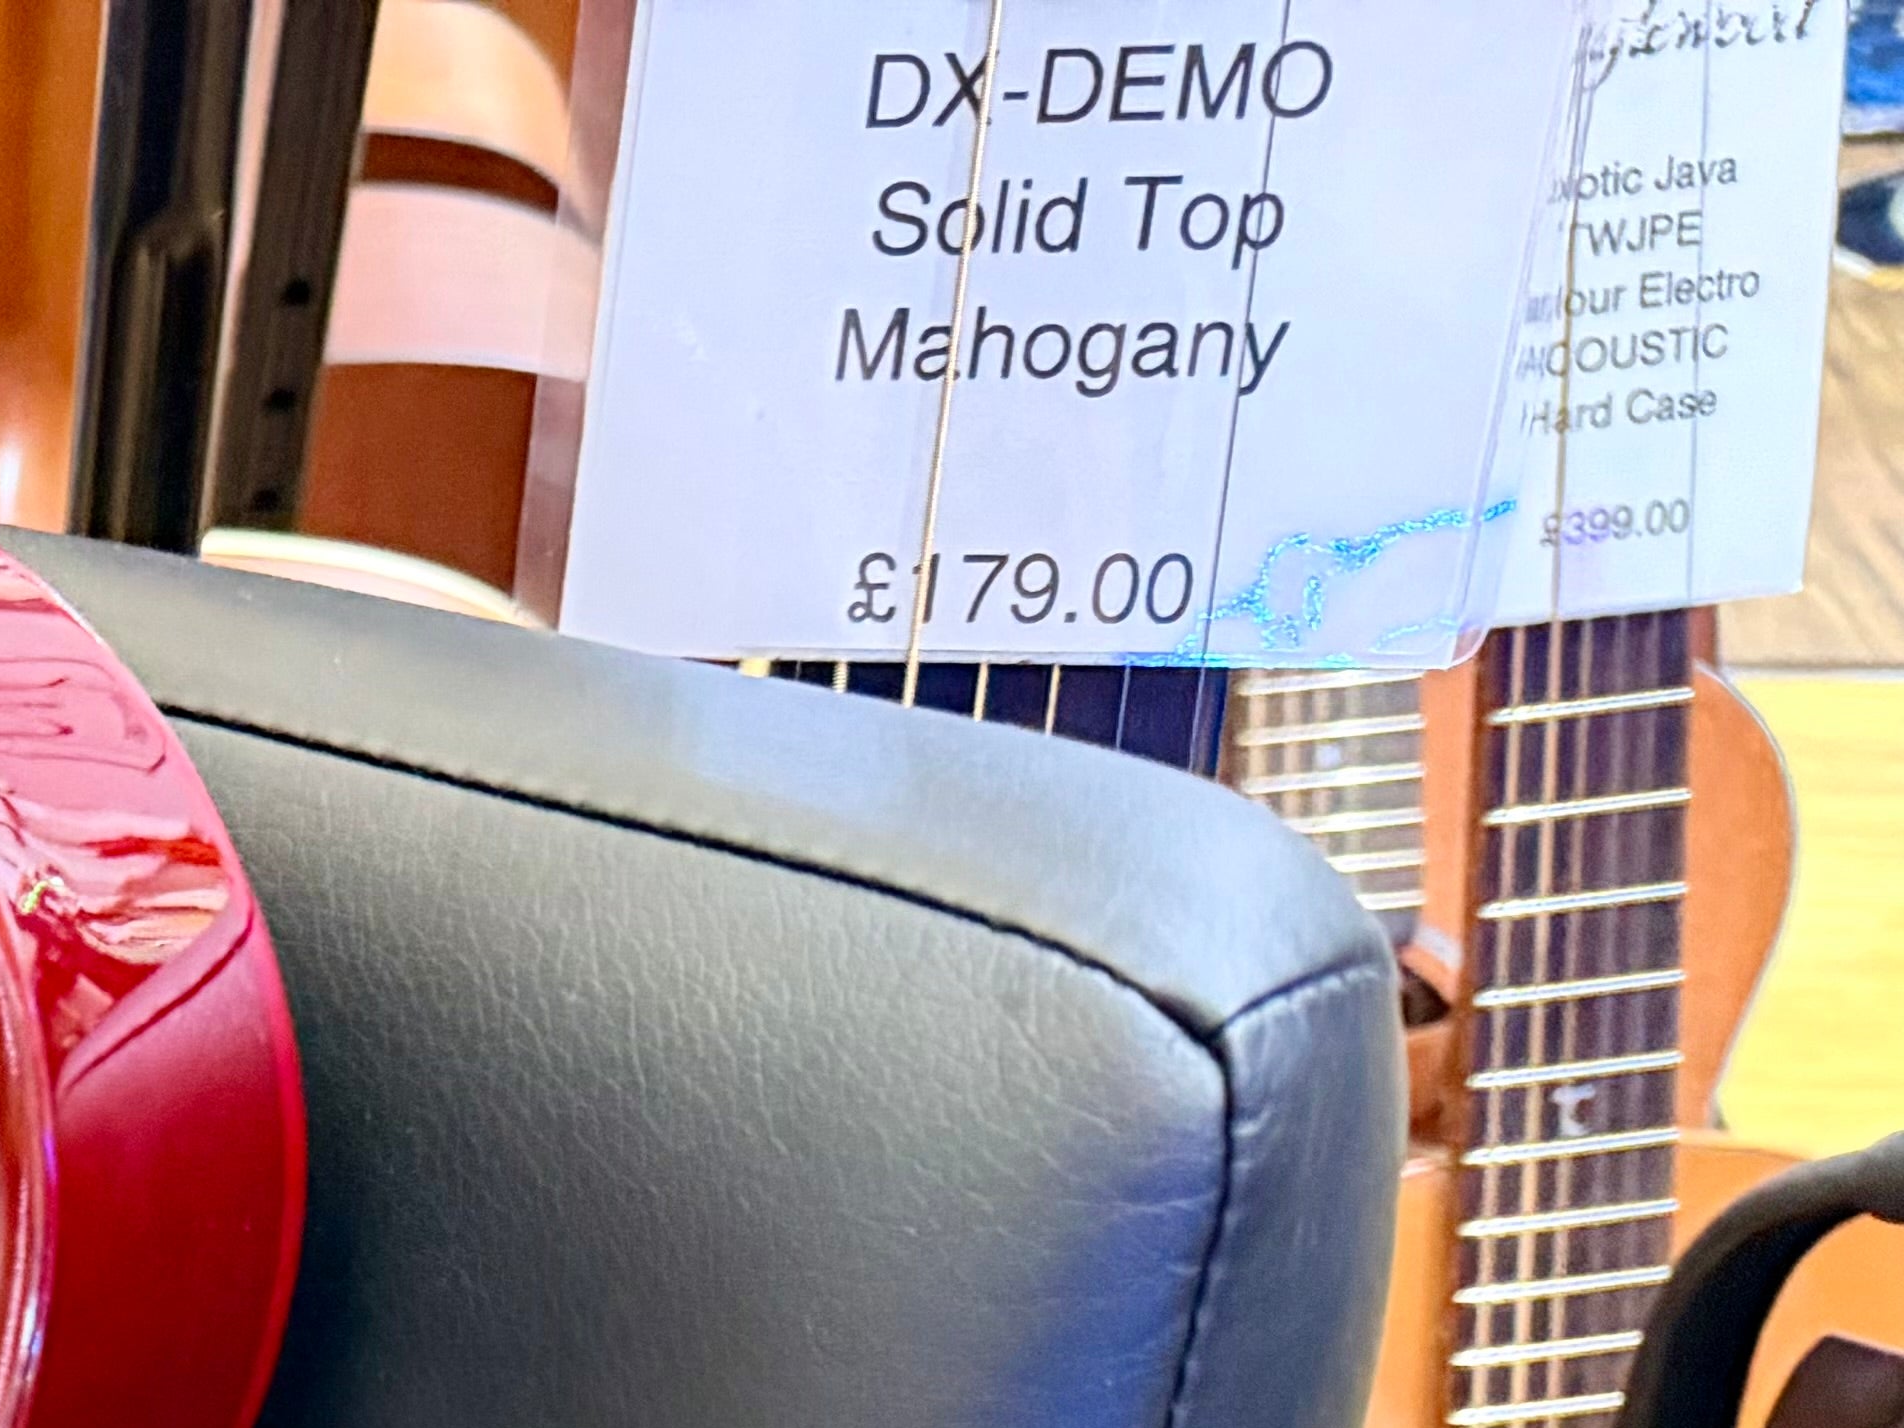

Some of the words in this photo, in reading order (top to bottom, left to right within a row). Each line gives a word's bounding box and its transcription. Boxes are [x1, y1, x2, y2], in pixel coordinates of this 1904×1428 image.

[865, 40, 1334, 129] DX-DEMO
[1654, 154, 1738, 192] Java
[872, 177, 1089, 257] Solid
[1124, 174, 1285, 270] Top
[1639, 269, 1761, 309] Electro
[835, 306, 1290, 398] Mahogany
[1626, 388, 1718, 425] Case
[847, 551, 1195, 625] £179.00
